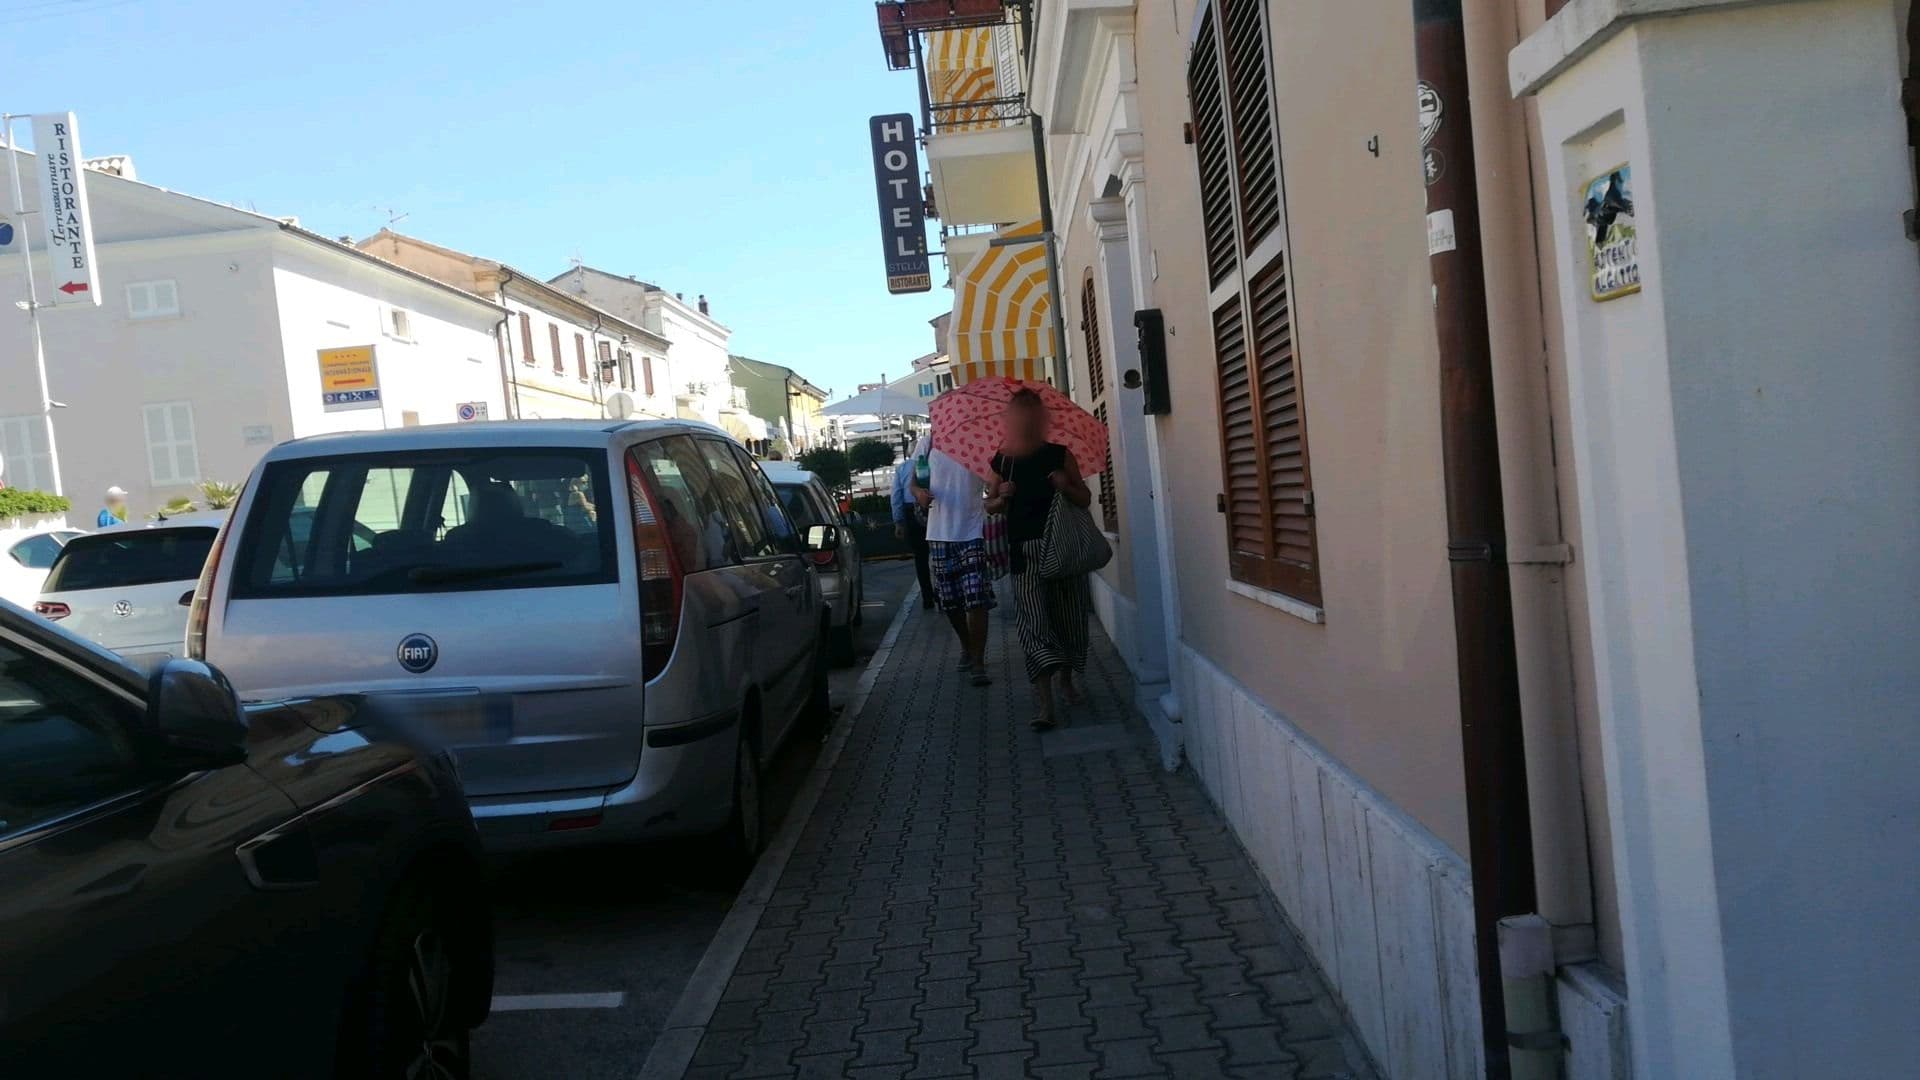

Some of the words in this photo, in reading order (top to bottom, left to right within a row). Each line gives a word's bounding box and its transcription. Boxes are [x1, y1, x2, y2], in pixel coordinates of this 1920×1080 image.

[54, 122, 84, 269] RISTORANTE
[881, 120, 916, 257] HOTEL
[888, 261, 927, 272] STELLA
[890, 275, 929, 289] RISTORANTE
[404, 647, 430, 660] FIAT
